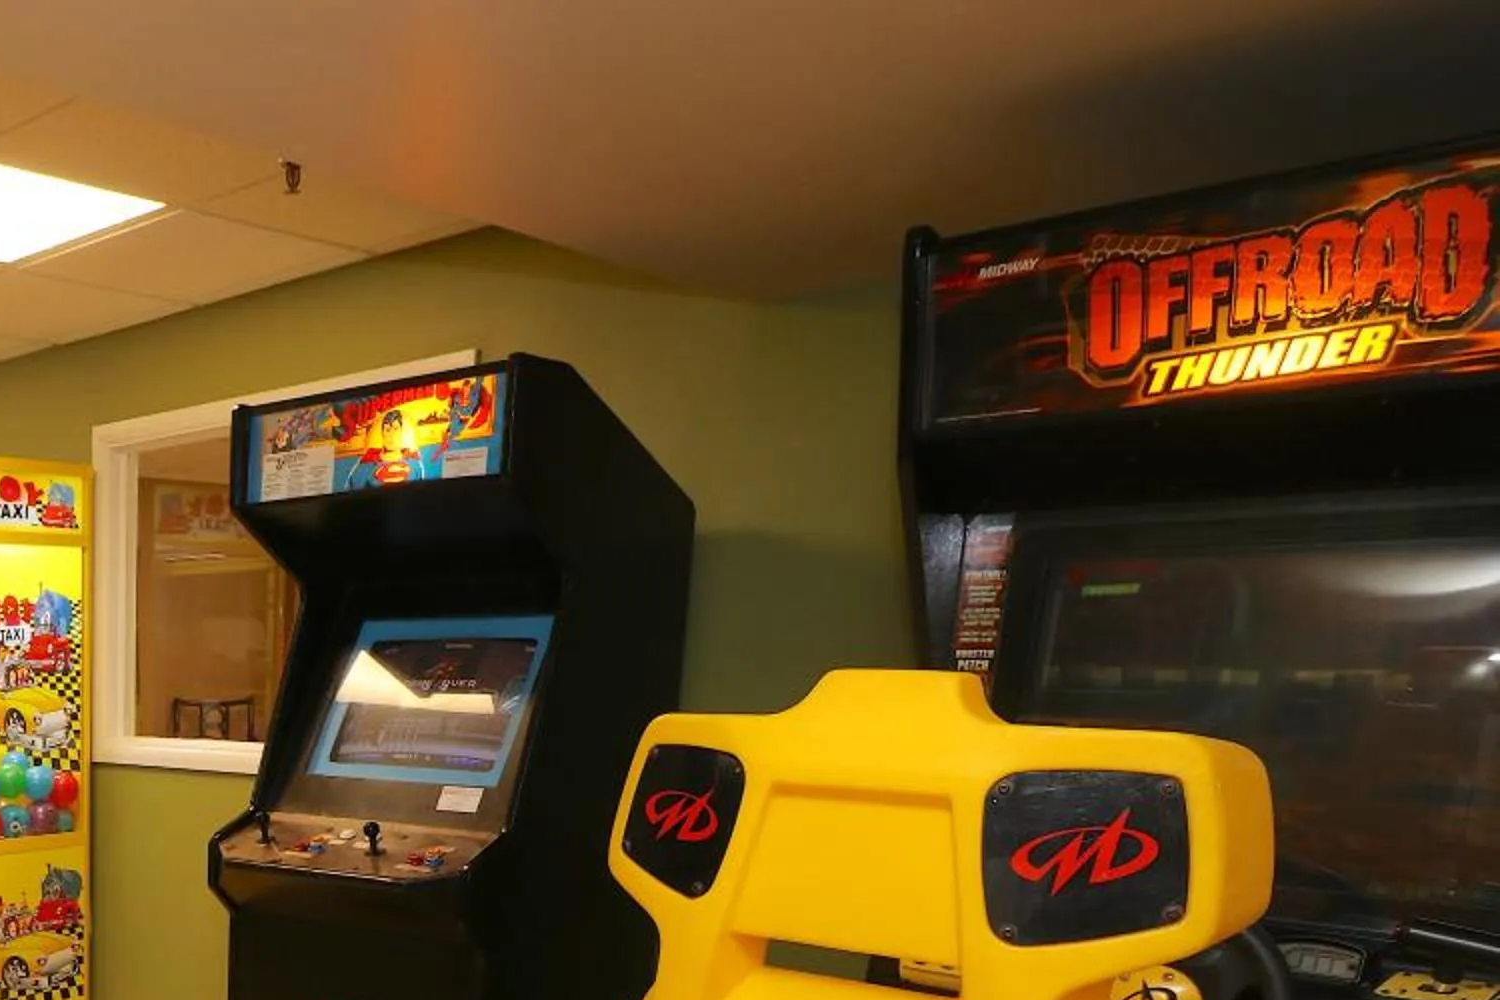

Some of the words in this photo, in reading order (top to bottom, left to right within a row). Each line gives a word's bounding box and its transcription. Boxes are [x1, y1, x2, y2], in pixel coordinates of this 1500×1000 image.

[977, 257, 1041, 280] MIDWAY
[1085, 183, 1491, 370] OFFROAD
[1145, 322, 1397, 396] THUNDER
[0, 627, 26, 644] TAXI
